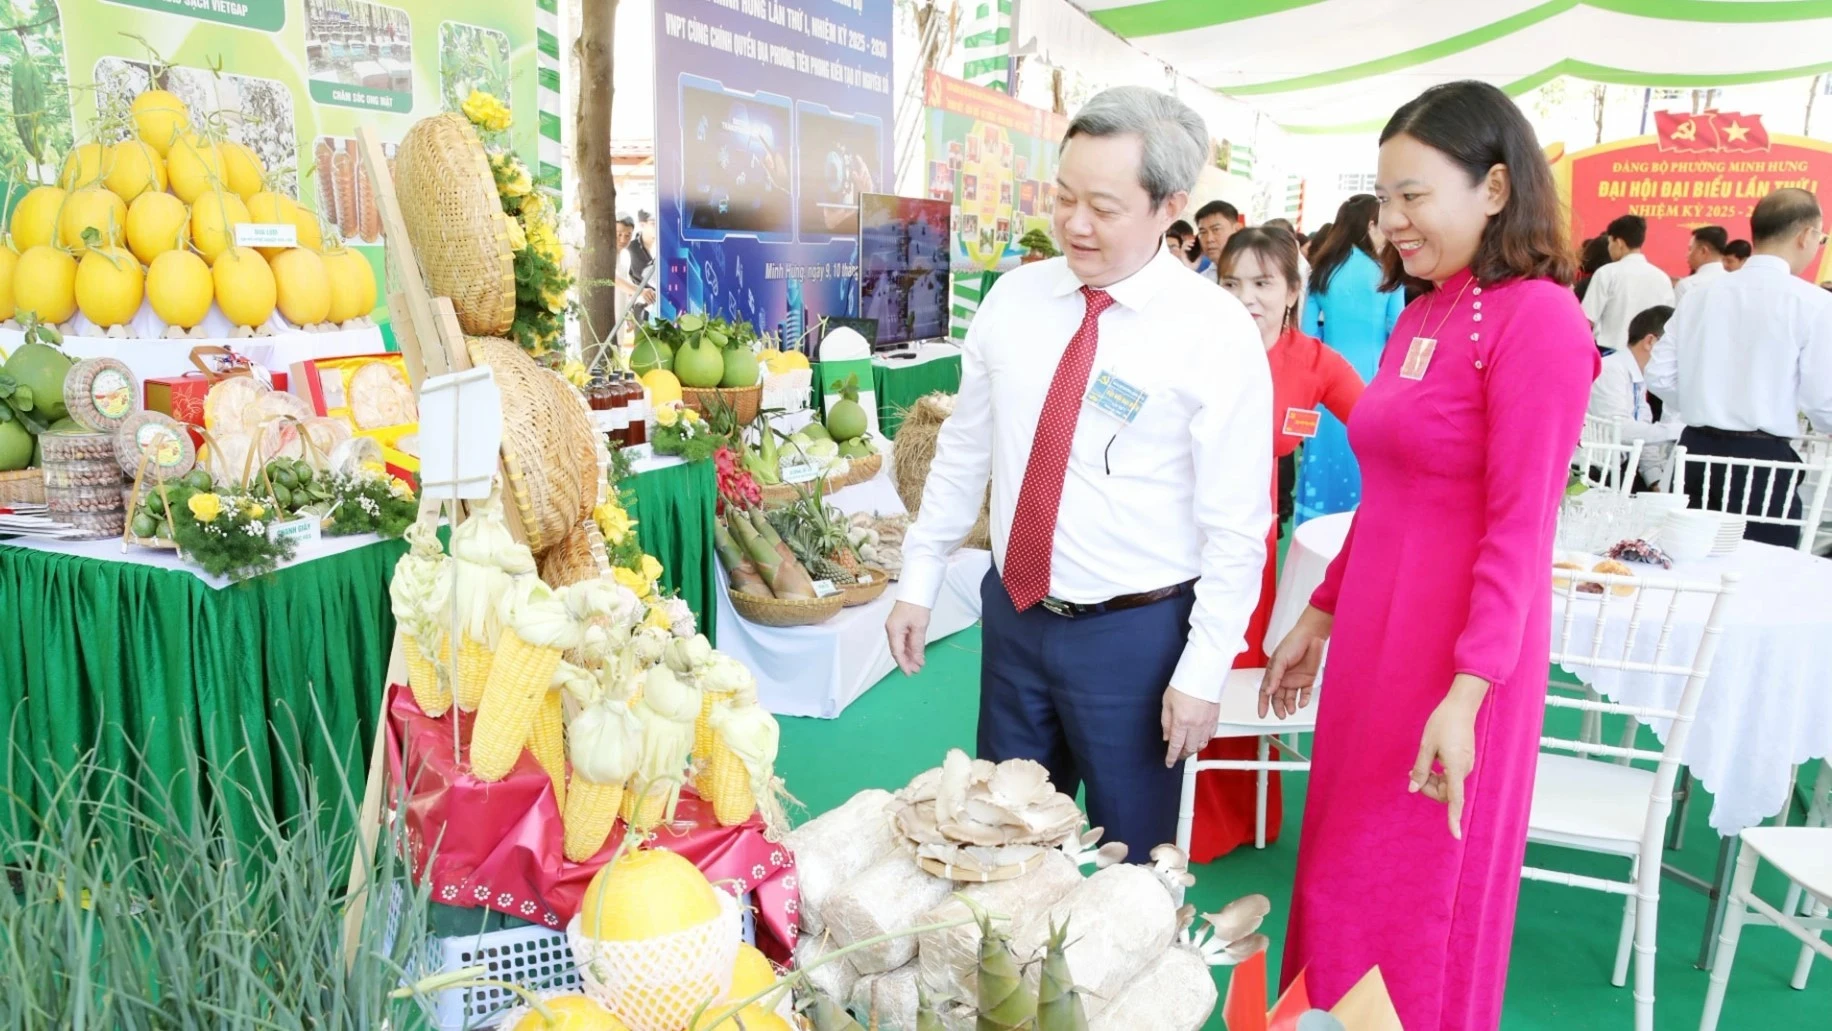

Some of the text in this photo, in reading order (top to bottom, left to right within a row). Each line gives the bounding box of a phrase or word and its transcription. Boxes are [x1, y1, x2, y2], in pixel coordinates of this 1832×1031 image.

[212, 0, 248, 17] VIETGAP
[665, 12, 687, 40] VNPT
[786, 8, 804, 32] THỨ
[811, 17, 837, 45] NHIỆM
[1651, 160, 1669, 175] BỘ
[1728, 161, 1765, 172] MINH
[1598, 180, 1627, 201] ĐẠI
[1629, 178, 1657, 201] HỘI
[1660, 180, 1688, 201] ĐẠI
[1628, 202, 1679, 220] NHIỆM
[1705, 205, 1735, 218] 2025
[764, 262, 784, 280] Minh
[833, 262, 841, 278] 10
